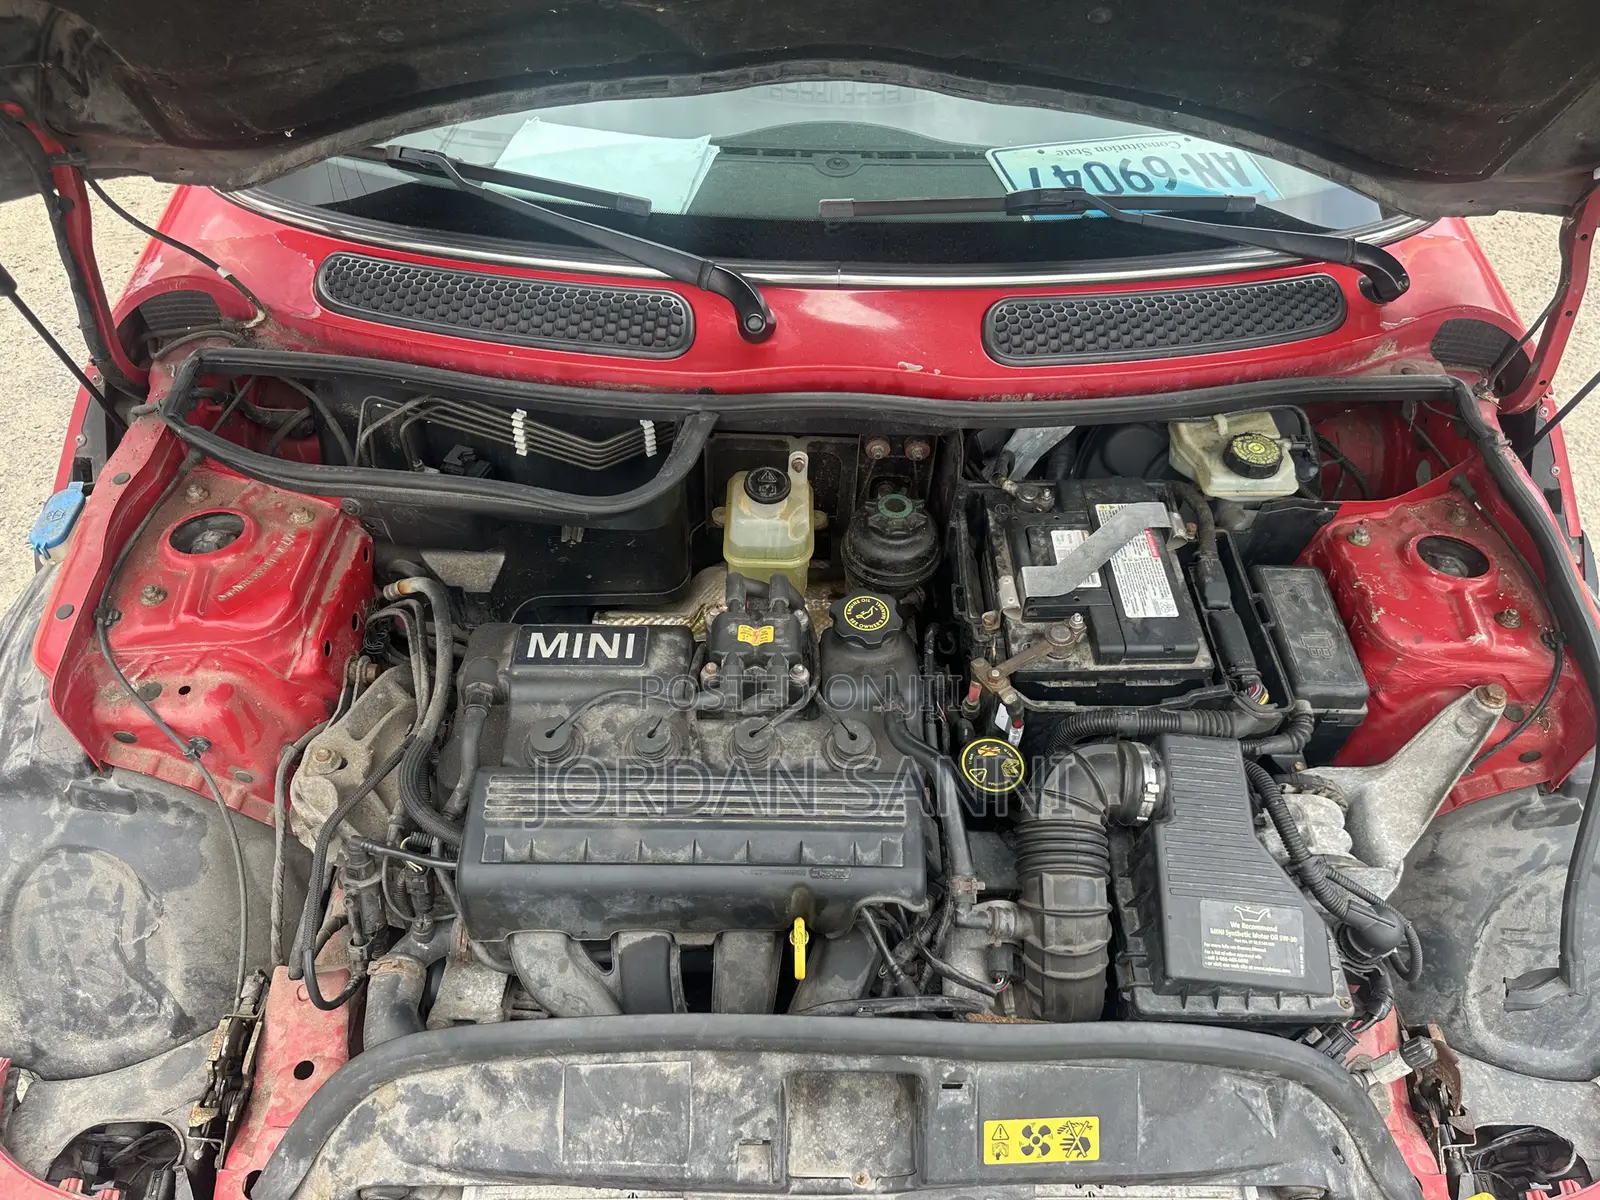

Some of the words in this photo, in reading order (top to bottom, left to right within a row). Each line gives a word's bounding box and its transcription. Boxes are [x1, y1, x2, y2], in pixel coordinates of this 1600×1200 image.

[1055, 146, 1092, 158] State
[1097, 139, 1182, 155] Constitution
[526, 632, 636, 659] MINI
[1241, 922, 1278, 932] Recommend
